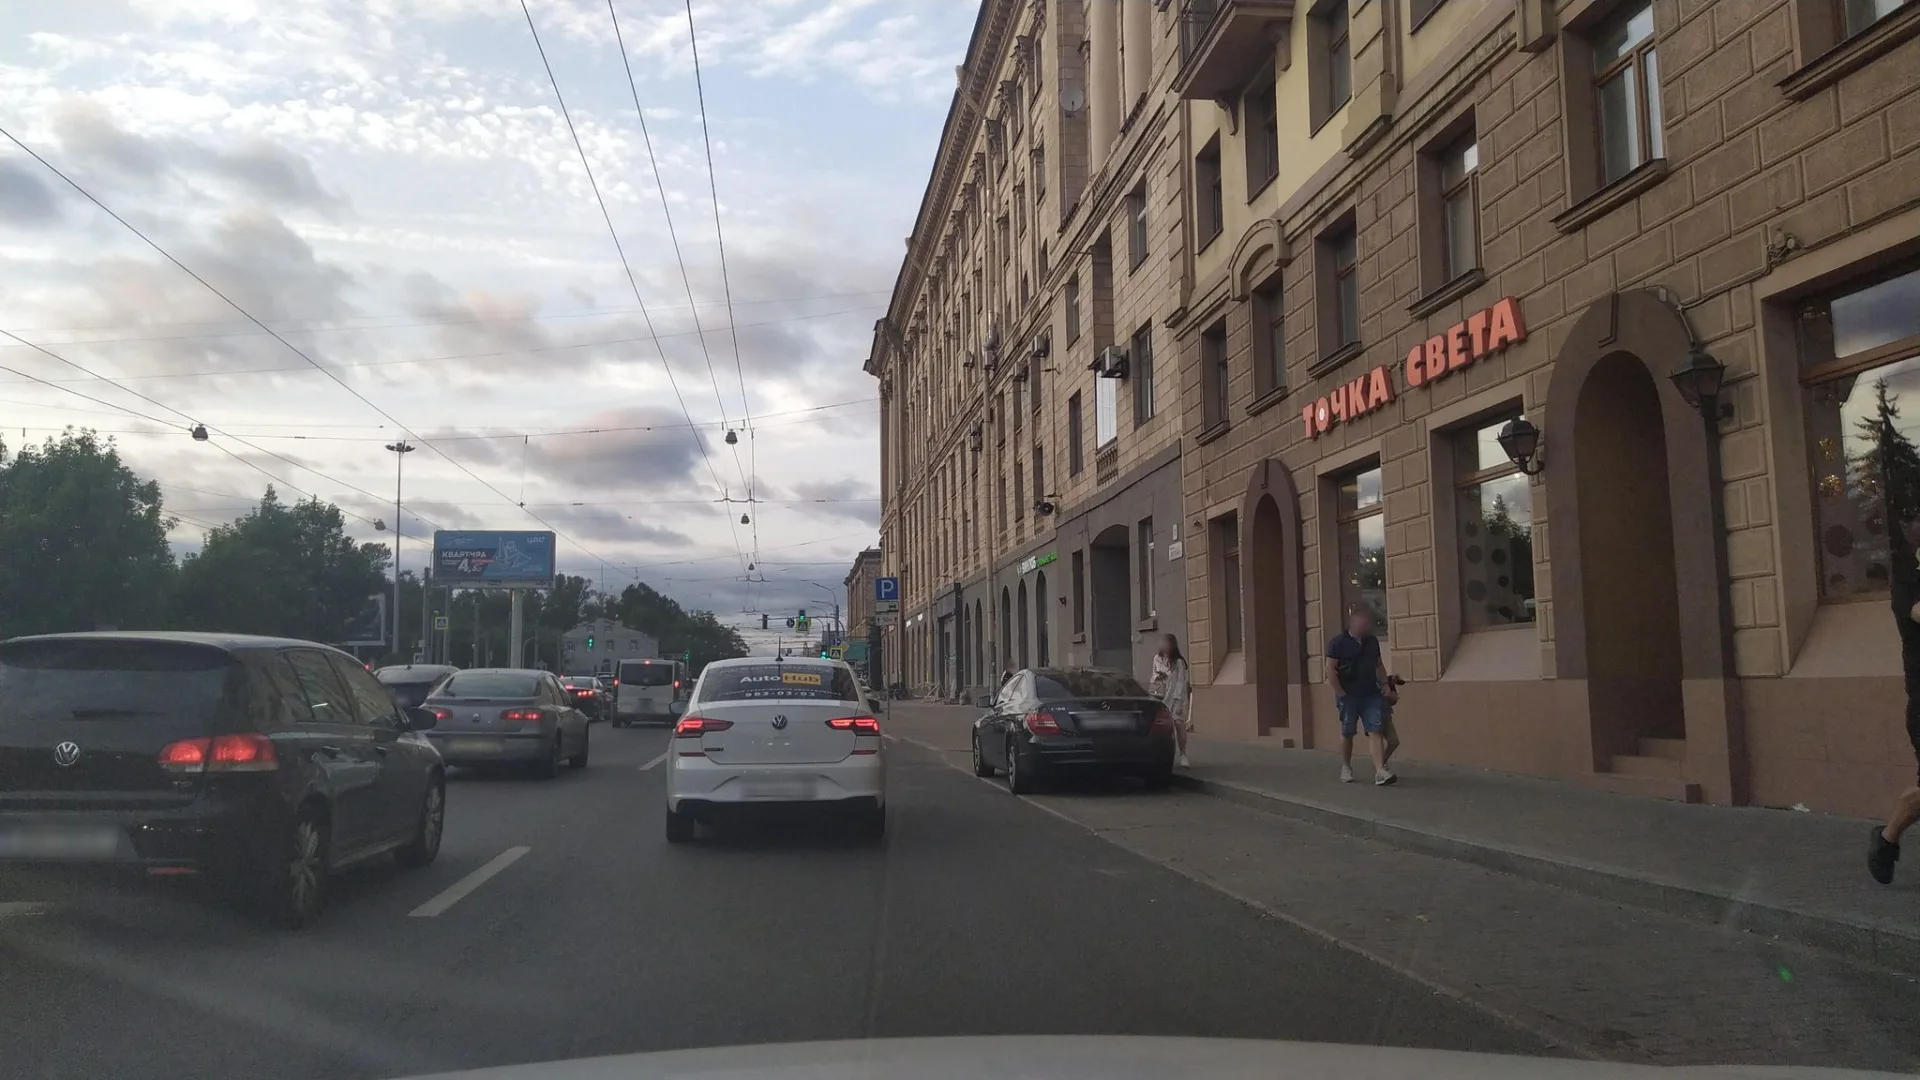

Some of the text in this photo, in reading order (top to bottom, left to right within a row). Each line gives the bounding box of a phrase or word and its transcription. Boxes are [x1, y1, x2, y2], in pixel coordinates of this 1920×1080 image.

[1302, 296, 1526, 439] ТОЧКА СВЕТА
[441, 550, 487, 558] КВАРТИРА
[880, 578, 894, 599] P
[739, 674, 820, 684] Auto Hub
